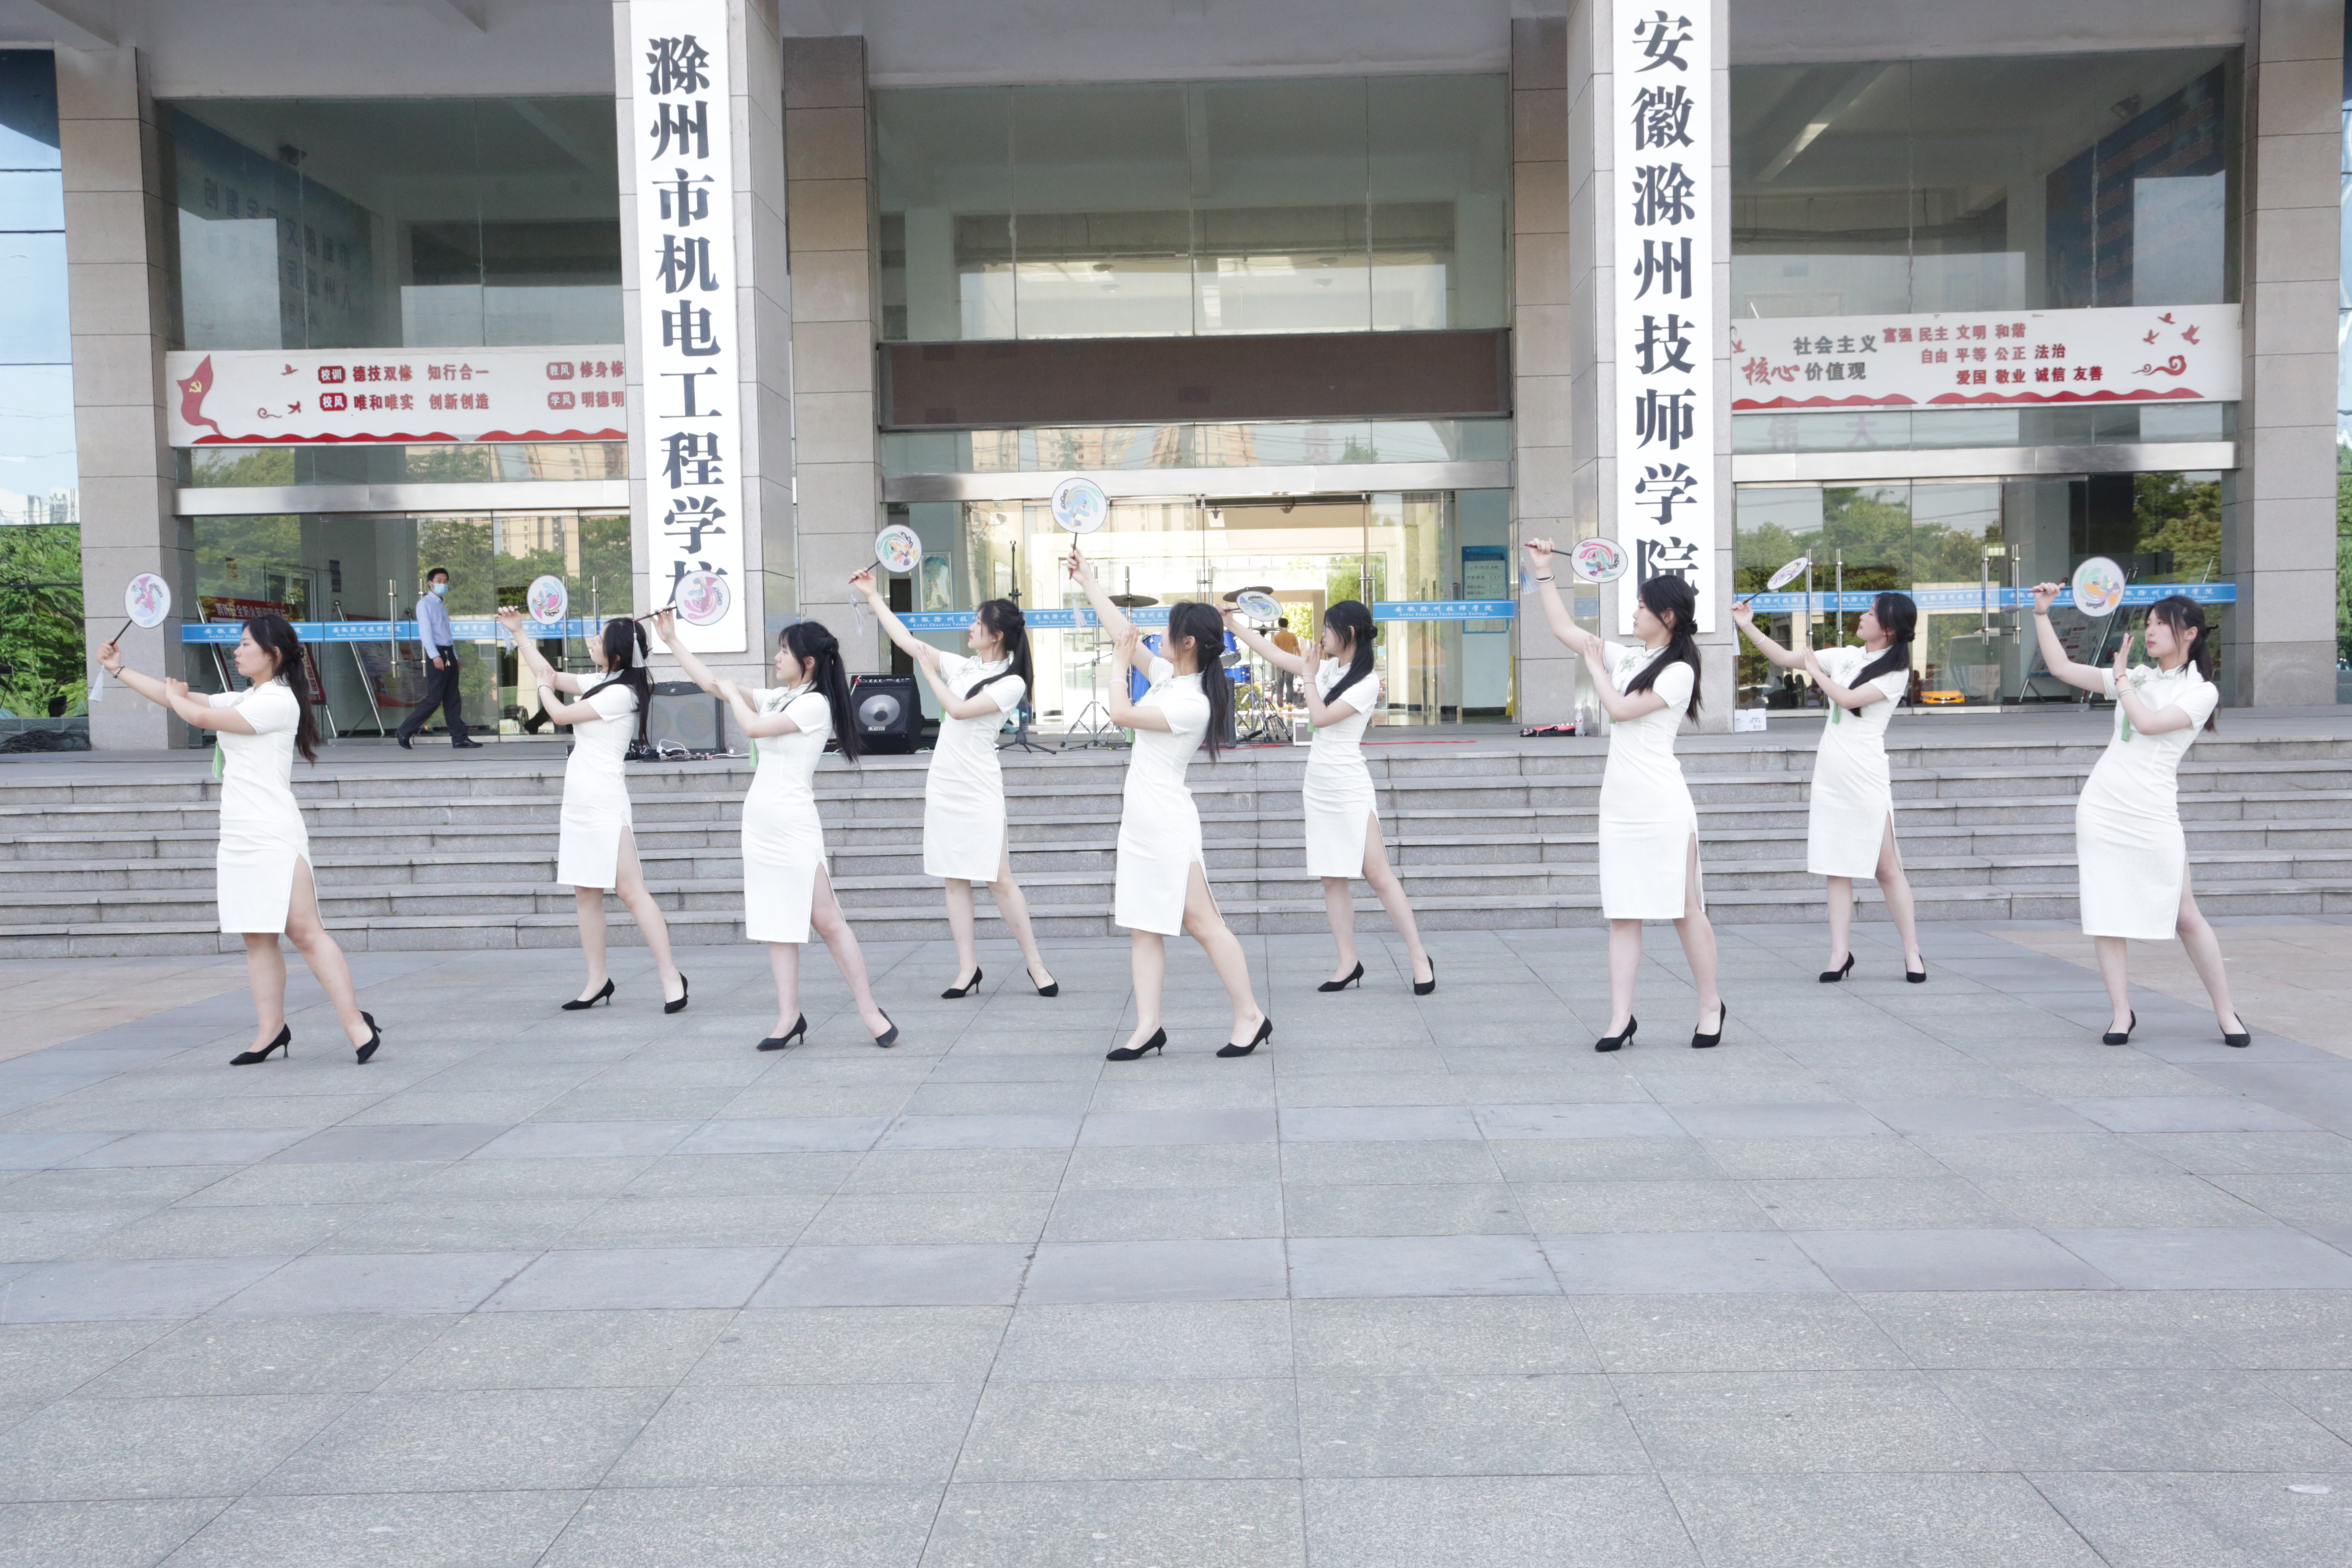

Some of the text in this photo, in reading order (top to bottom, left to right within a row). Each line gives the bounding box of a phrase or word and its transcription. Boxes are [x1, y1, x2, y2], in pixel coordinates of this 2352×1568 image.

[1883, 323, 2026, 343] 富强 民主 文明 和谐
[1793, 335, 1877, 355] 社会主义
[1922, 343, 2066, 363] 自由 平等 公正 法治
[321, 363, 489, 382] 校训 德技双修 知行合一
[550, 361, 624, 378] 教风 修身修
[1742, 357, 1866, 385] 核心 价值观
[1956, 366, 2103, 385] 爱国 敬业 诚信 友善
[323, 393, 489, 410] 校风 唯和唯实 创新创造
[551, 391, 624, 408] 学风 明德明
[1394, 604, 1493, 612] 安徽滁州技师学院
